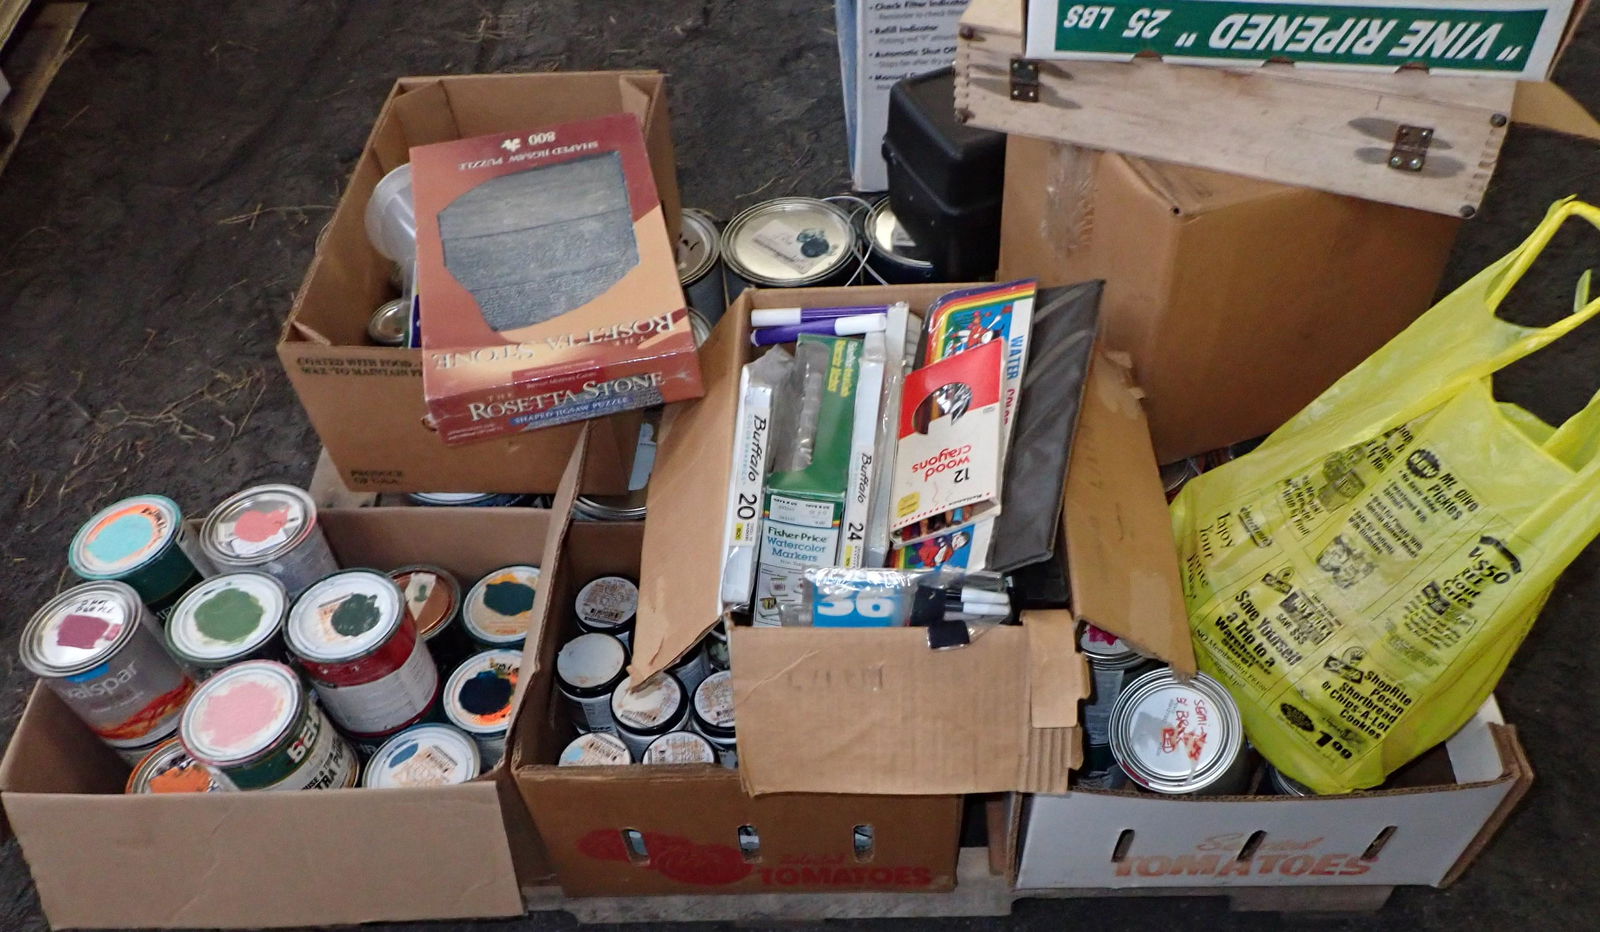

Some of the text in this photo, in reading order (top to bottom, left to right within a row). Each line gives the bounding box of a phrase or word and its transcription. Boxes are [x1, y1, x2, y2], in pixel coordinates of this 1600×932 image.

[1063, 4, 1116, 30] LBS
[1121, 8, 1173, 39] 25
[875, 49, 919, 58] Automatic
[529, 131, 557, 146] 800
[457, 140, 599, 172] SHAPED JIGSAW PUZZLE
[548, 311, 674, 351] ROSETTA
[433, 342, 535, 370] STONE
[1007, 334, 1025, 380] WATER
[467, 389, 583, 422] ROSETTA
[582, 371, 666, 398] STONE
[513, 395, 631, 425] SHAPED JIGSAW PUZZLE
[748, 414, 767, 482] Buffalo
[911, 444, 973, 474] crayons
[857, 452, 872, 504] Buffalo
[924, 455, 971, 483] wood
[953, 467, 970, 484] 12
[1408, 452, 1440, 478] NEW
[736, 493, 758, 521] 20
[1427, 483, 1463, 520] Pickles
[1439, 472, 1479, 512] Mt. Olive
[767, 536, 827, 554] Watercolor
[847, 521, 864, 541] 24
[771, 548, 818, 562] Markers
[816, 585, 897, 618] 36
[1226, 612, 1239, 624] a
[1235, 620, 1256, 645] Trip
[1253, 641, 1268, 658] to
[1265, 657, 1276, 668] a
[1235, 590, 1260, 622] Save
[1257, 617, 1303, 666] Yourself
[1215, 616, 1273, 676] Warehouse
[1340, 682, 1398, 724] Shortbread
[1364, 670, 1413, 707] ShopRite
[1368, 688, 1405, 715] Pecan
[1321, 680, 1332, 692] Or
[1329, 688, 1391, 733] Chips-A-Lot
[1340, 709, 1382, 740] Cookies
[758, 865, 934, 887] TOMATOES
[1113, 853, 1380, 877] TOMATOES
